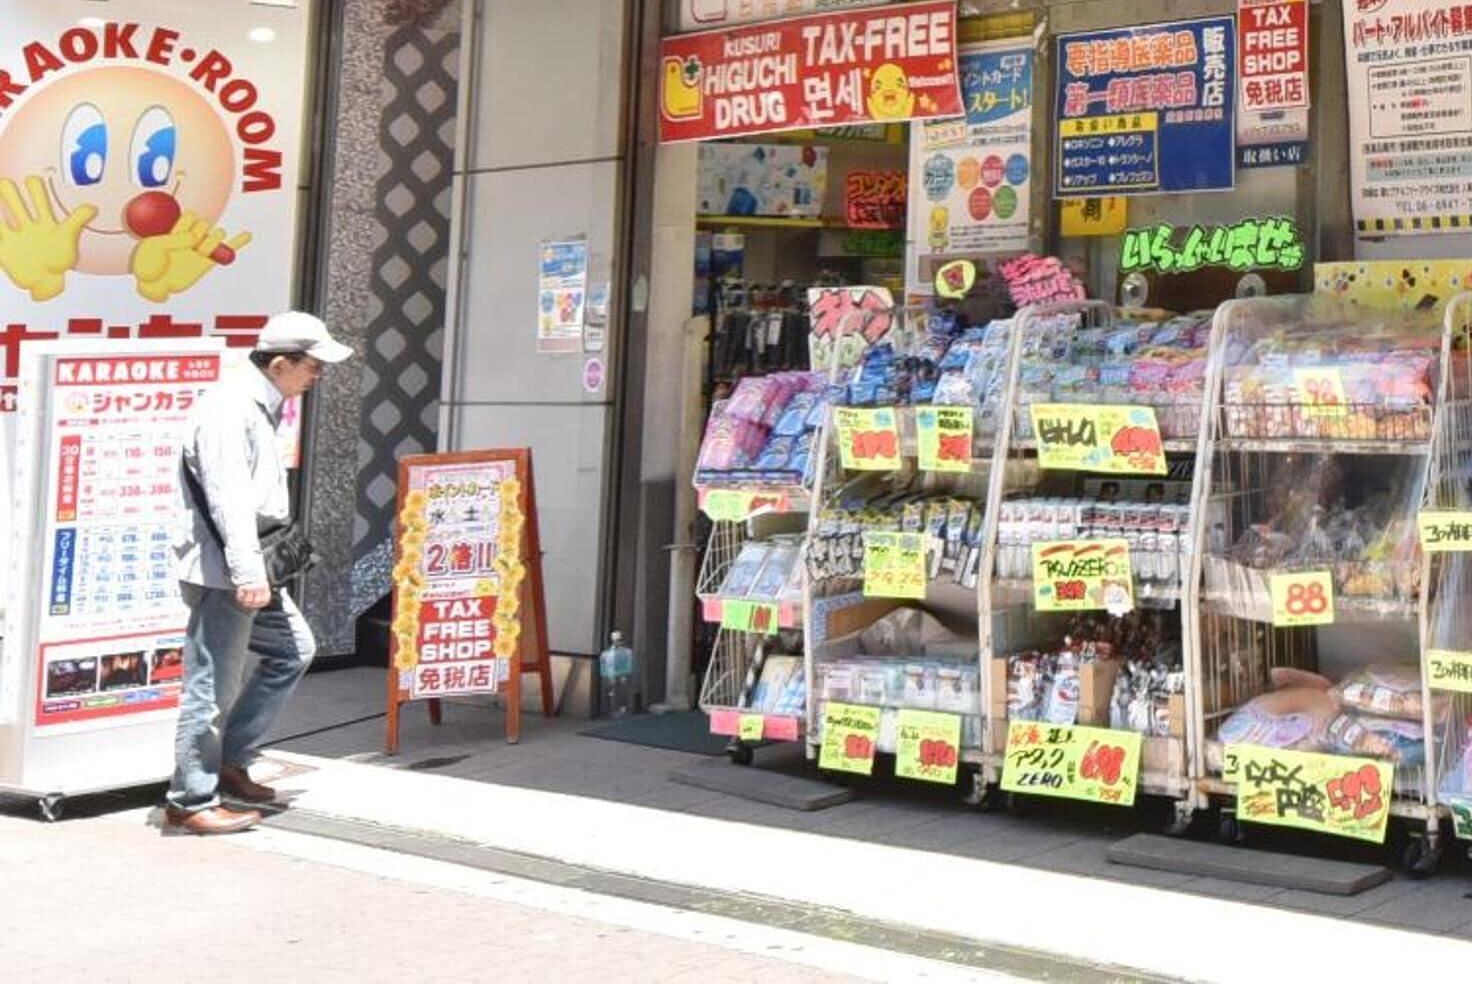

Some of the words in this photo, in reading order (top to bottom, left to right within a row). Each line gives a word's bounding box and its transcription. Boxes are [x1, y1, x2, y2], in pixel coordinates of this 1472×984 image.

[1251, 5, 1291, 27] TAX
[724, 32, 780, 58] KUSURI
[803, 12, 951, 66] TAX-FREE
[1245, 28, 1299, 51] FREE
[704, 53, 796, 95] HIGUCHI
[1202, 26, 1225, 106] 販売店
[1244, 50, 1301, 74] SHOP
[803, 68, 864, 118] 면세
[1246, 78, 1303, 106] 免税店
[715, 91, 786, 130] DRUG
[59, 361, 180, 383] KARAOKE
[93, 391, 193, 413] ジャンカラ
[434, 601, 483, 619] TAX
[1286, 582, 1328, 615] 88
[423, 620, 490, 640] FREE
[420, 640, 492, 662] SHOP
[418, 665, 491, 692] 免税店
